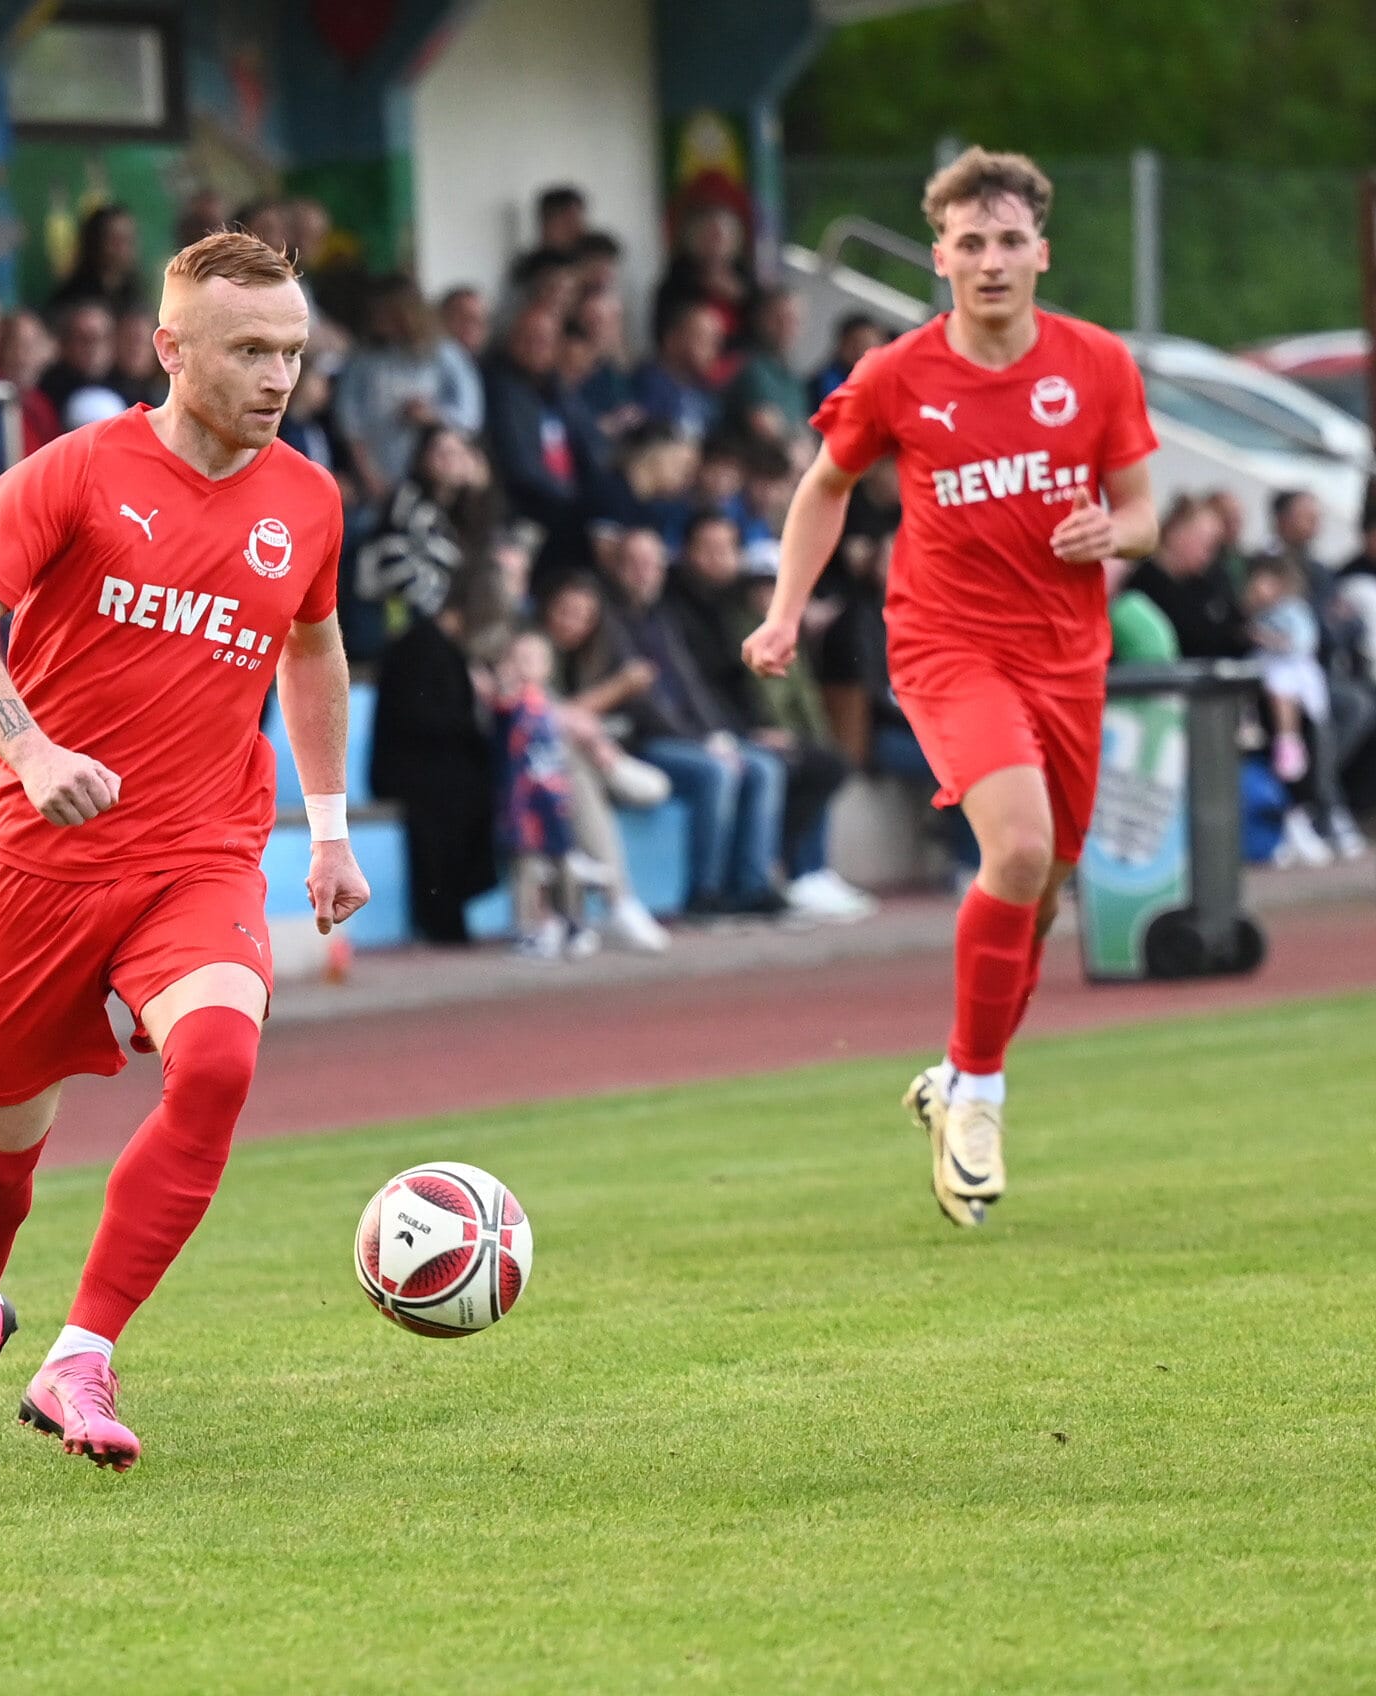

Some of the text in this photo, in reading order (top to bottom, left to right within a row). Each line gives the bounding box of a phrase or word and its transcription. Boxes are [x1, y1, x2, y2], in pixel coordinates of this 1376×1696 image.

[931, 450, 1054, 507] REWE
[97, 575, 241, 645] REWE
[397, 1211, 432, 1235] erima
